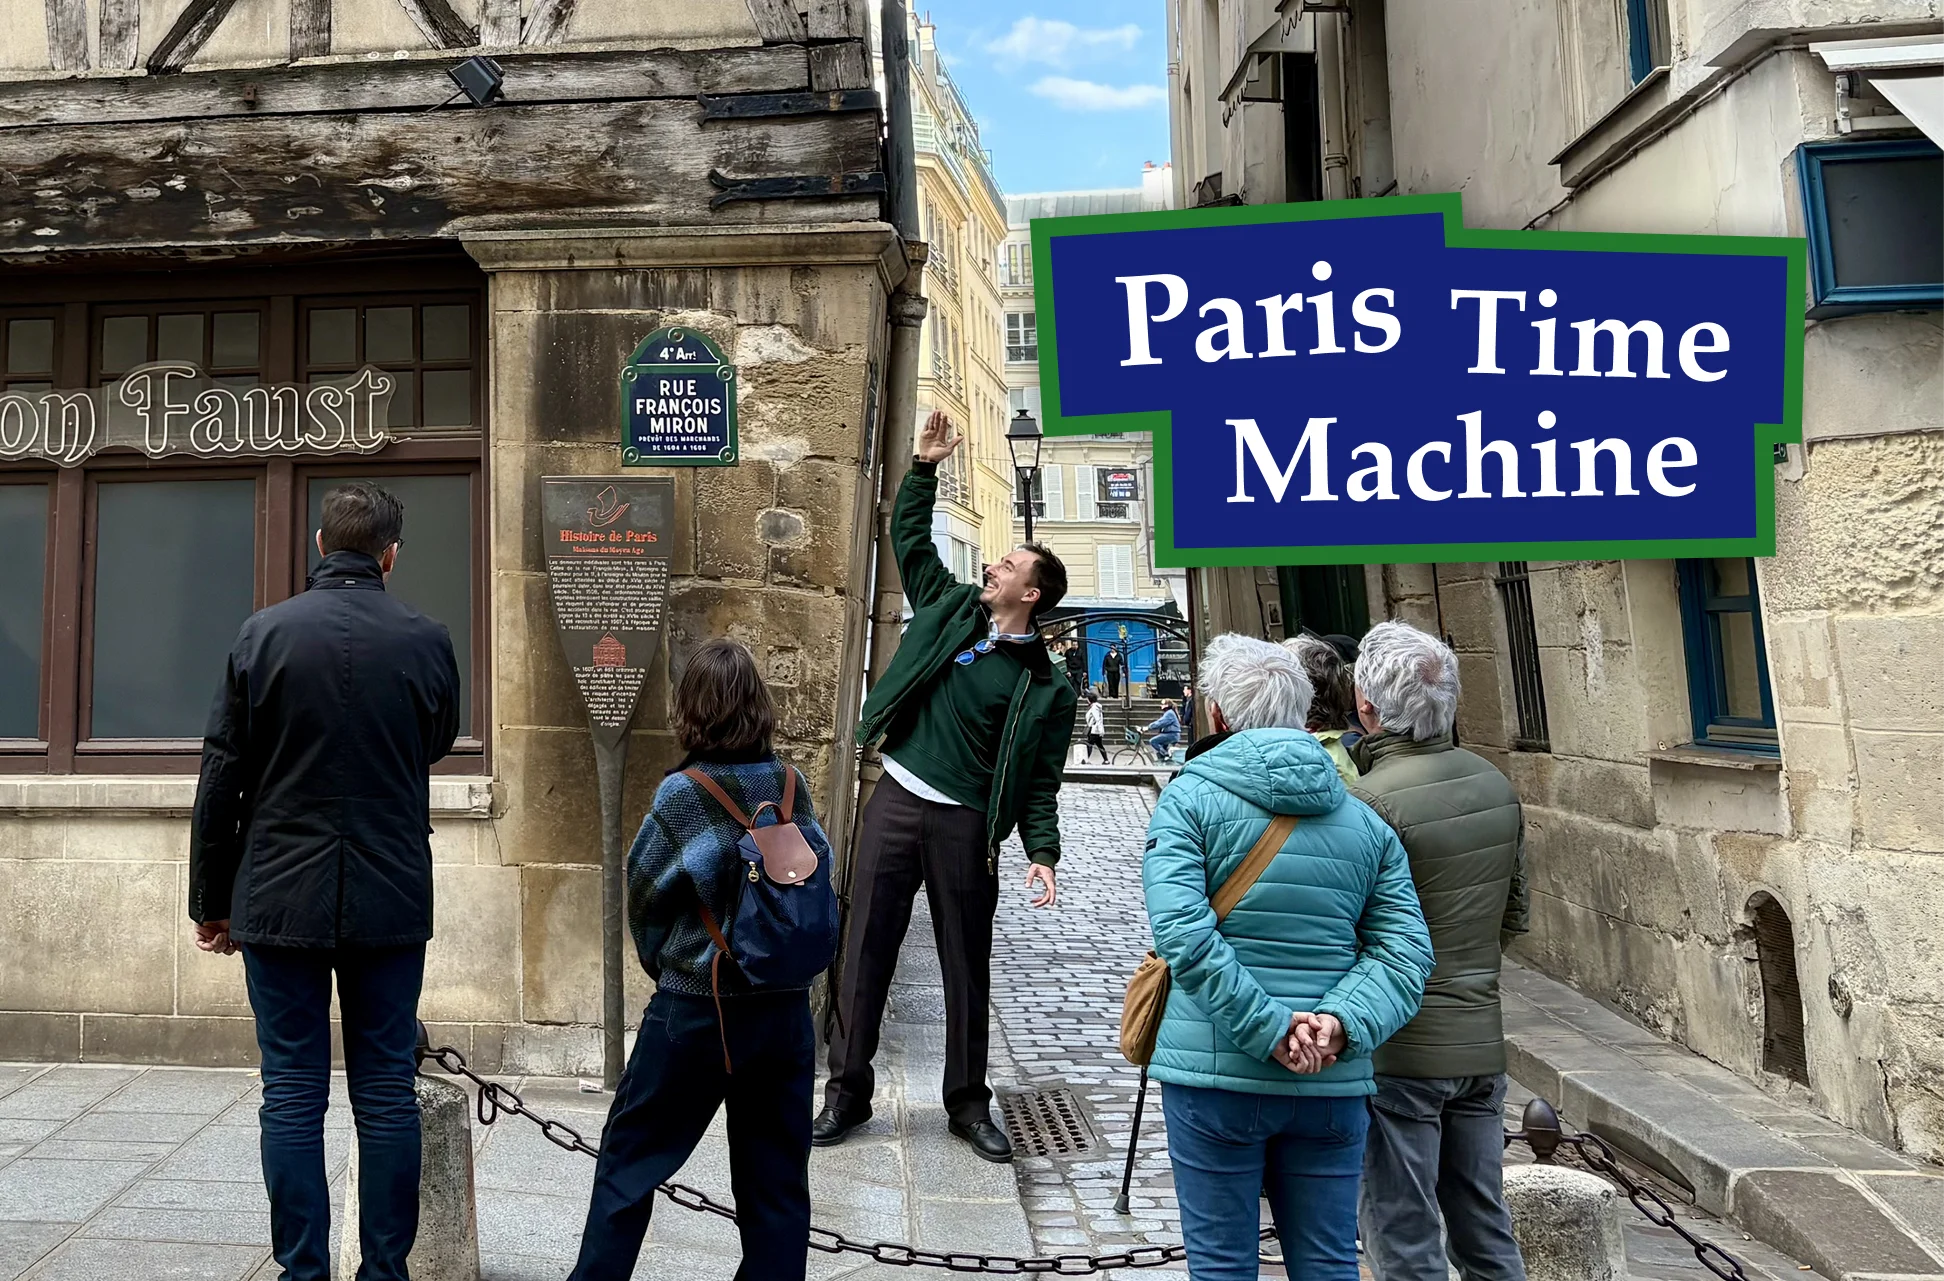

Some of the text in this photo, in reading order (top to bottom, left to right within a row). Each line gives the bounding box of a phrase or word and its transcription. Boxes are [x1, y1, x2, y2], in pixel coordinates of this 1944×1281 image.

[660, 380, 696, 395] RUE
[120, 365, 391, 453] Faust
[636, 399, 721, 417] FRANÇOIS
[651, 417, 707, 433] MIRON
[560, 530, 658, 543] Histoire de Paris
